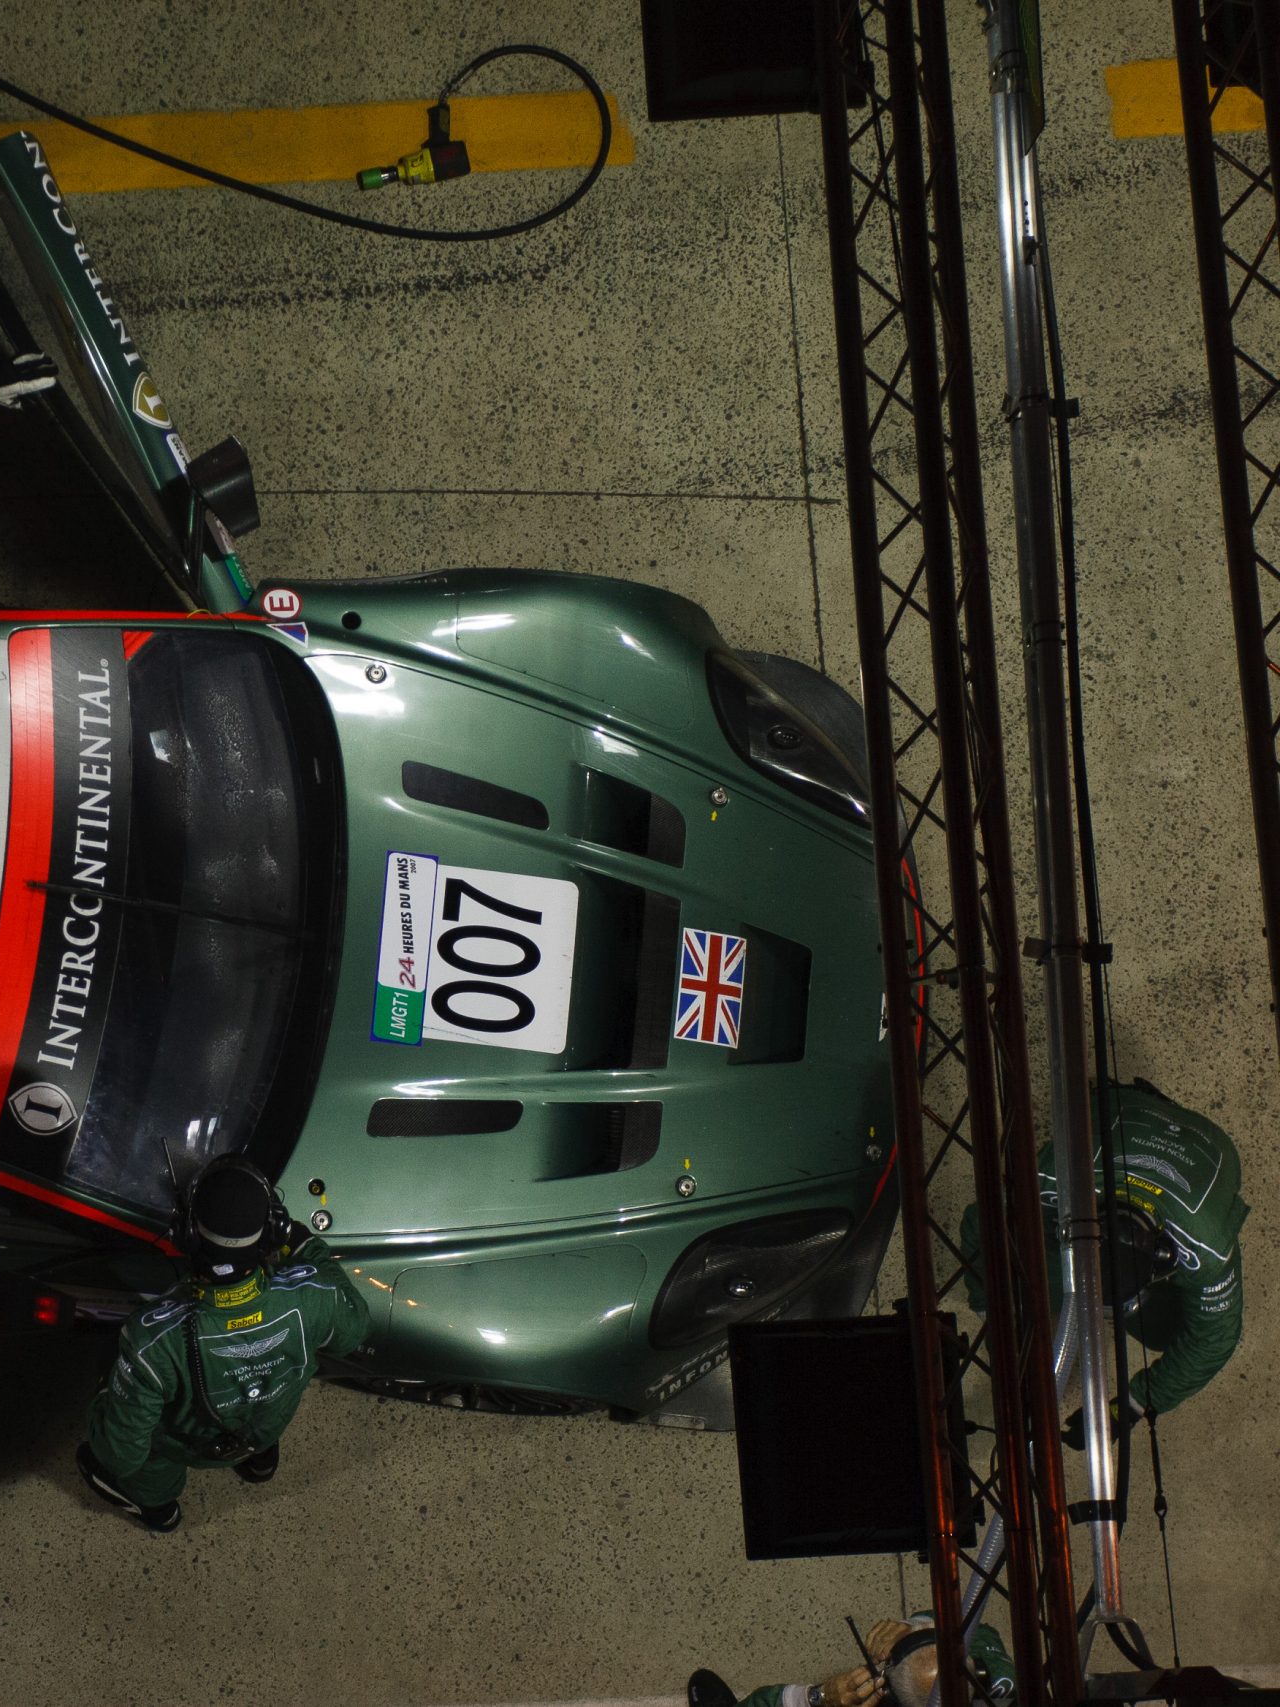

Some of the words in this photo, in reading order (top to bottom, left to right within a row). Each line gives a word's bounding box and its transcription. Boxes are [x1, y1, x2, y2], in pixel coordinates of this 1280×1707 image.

[396, 856, 410, 891] MANS
[399, 892, 412, 909] DU
[401, 911, 415, 954] HEURES
[399, 957, 417, 989] 24
[431, 877, 543, 1033] 007
[389, 991, 409, 1039] LMGT1
[238, 1369, 272, 1382] RACING
[659, 1350, 729, 1402] INFON
